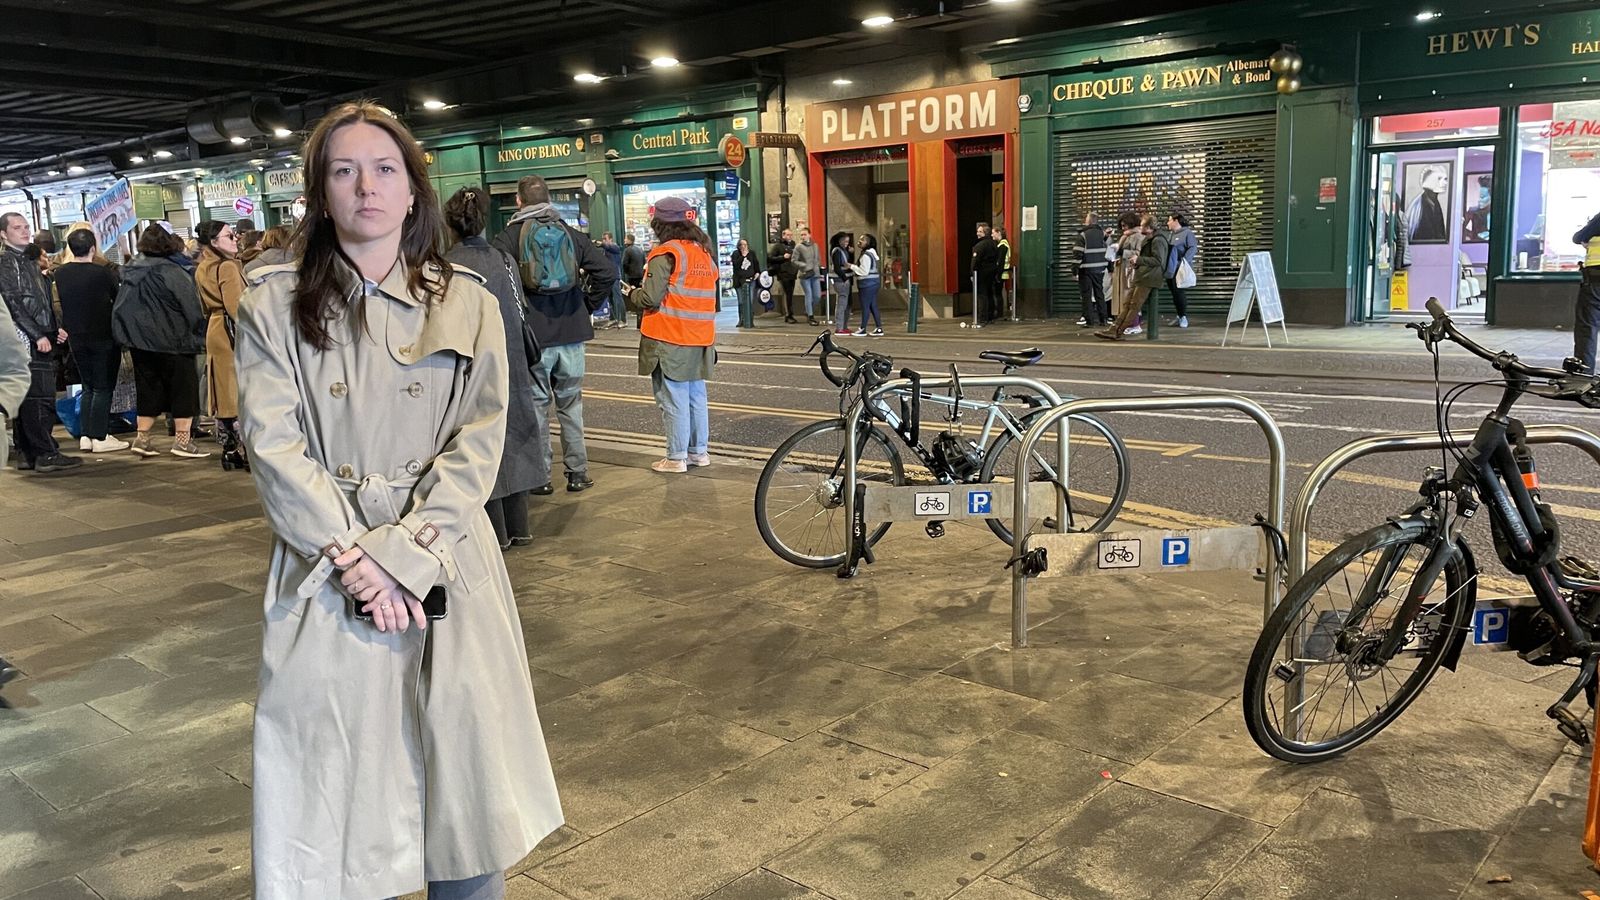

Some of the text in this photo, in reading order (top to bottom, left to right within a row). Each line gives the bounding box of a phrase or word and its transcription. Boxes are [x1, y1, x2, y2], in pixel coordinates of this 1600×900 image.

[1226, 59, 1269, 73] Albemar
[1053, 65, 1224, 101] CHEQUE & PAWN
[1232, 70, 1271, 85] & Bond
[822, 89, 997, 144] PLATFORM
[1427, 119, 1445, 128] 257
[632, 127, 710, 150] Central Park
[498, 143, 571, 163] KING OF BLING
[727, 143, 742, 156] 24
[974, 494, 988, 512] P
[1168, 541, 1185, 563] P
[1482, 613, 1504, 641] P
